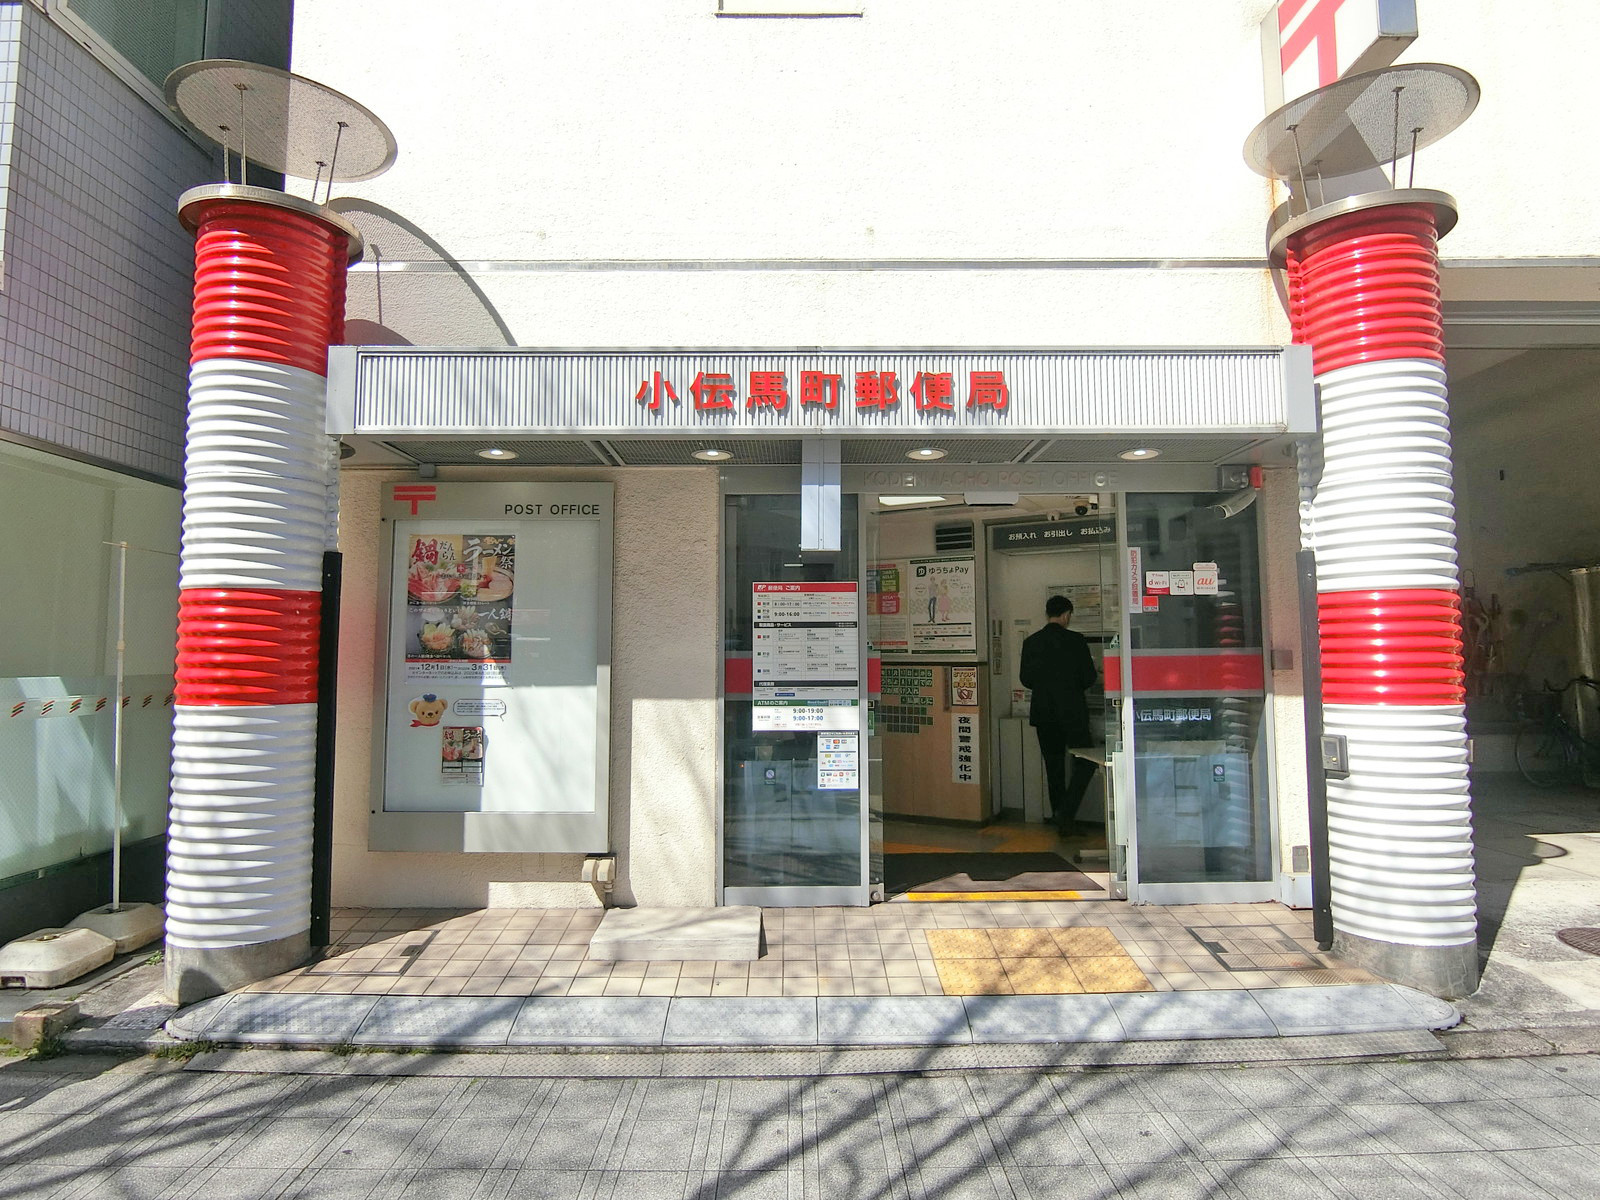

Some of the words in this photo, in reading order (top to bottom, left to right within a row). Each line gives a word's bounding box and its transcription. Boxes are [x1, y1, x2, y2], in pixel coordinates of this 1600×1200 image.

[635, 370, 1008, 411] 小伝馬町郵便局
[998, 471, 1043, 487] POST
[1052, 471, 1119, 487] OFFICE
[504, 504, 543, 515] POST
[550, 504, 600, 515] OFFICE
[928, 566, 969, 575] ゆうちょPay
[1196, 577, 1215, 586] au
[958, 716, 972, 782] 夜間警戒強化中
